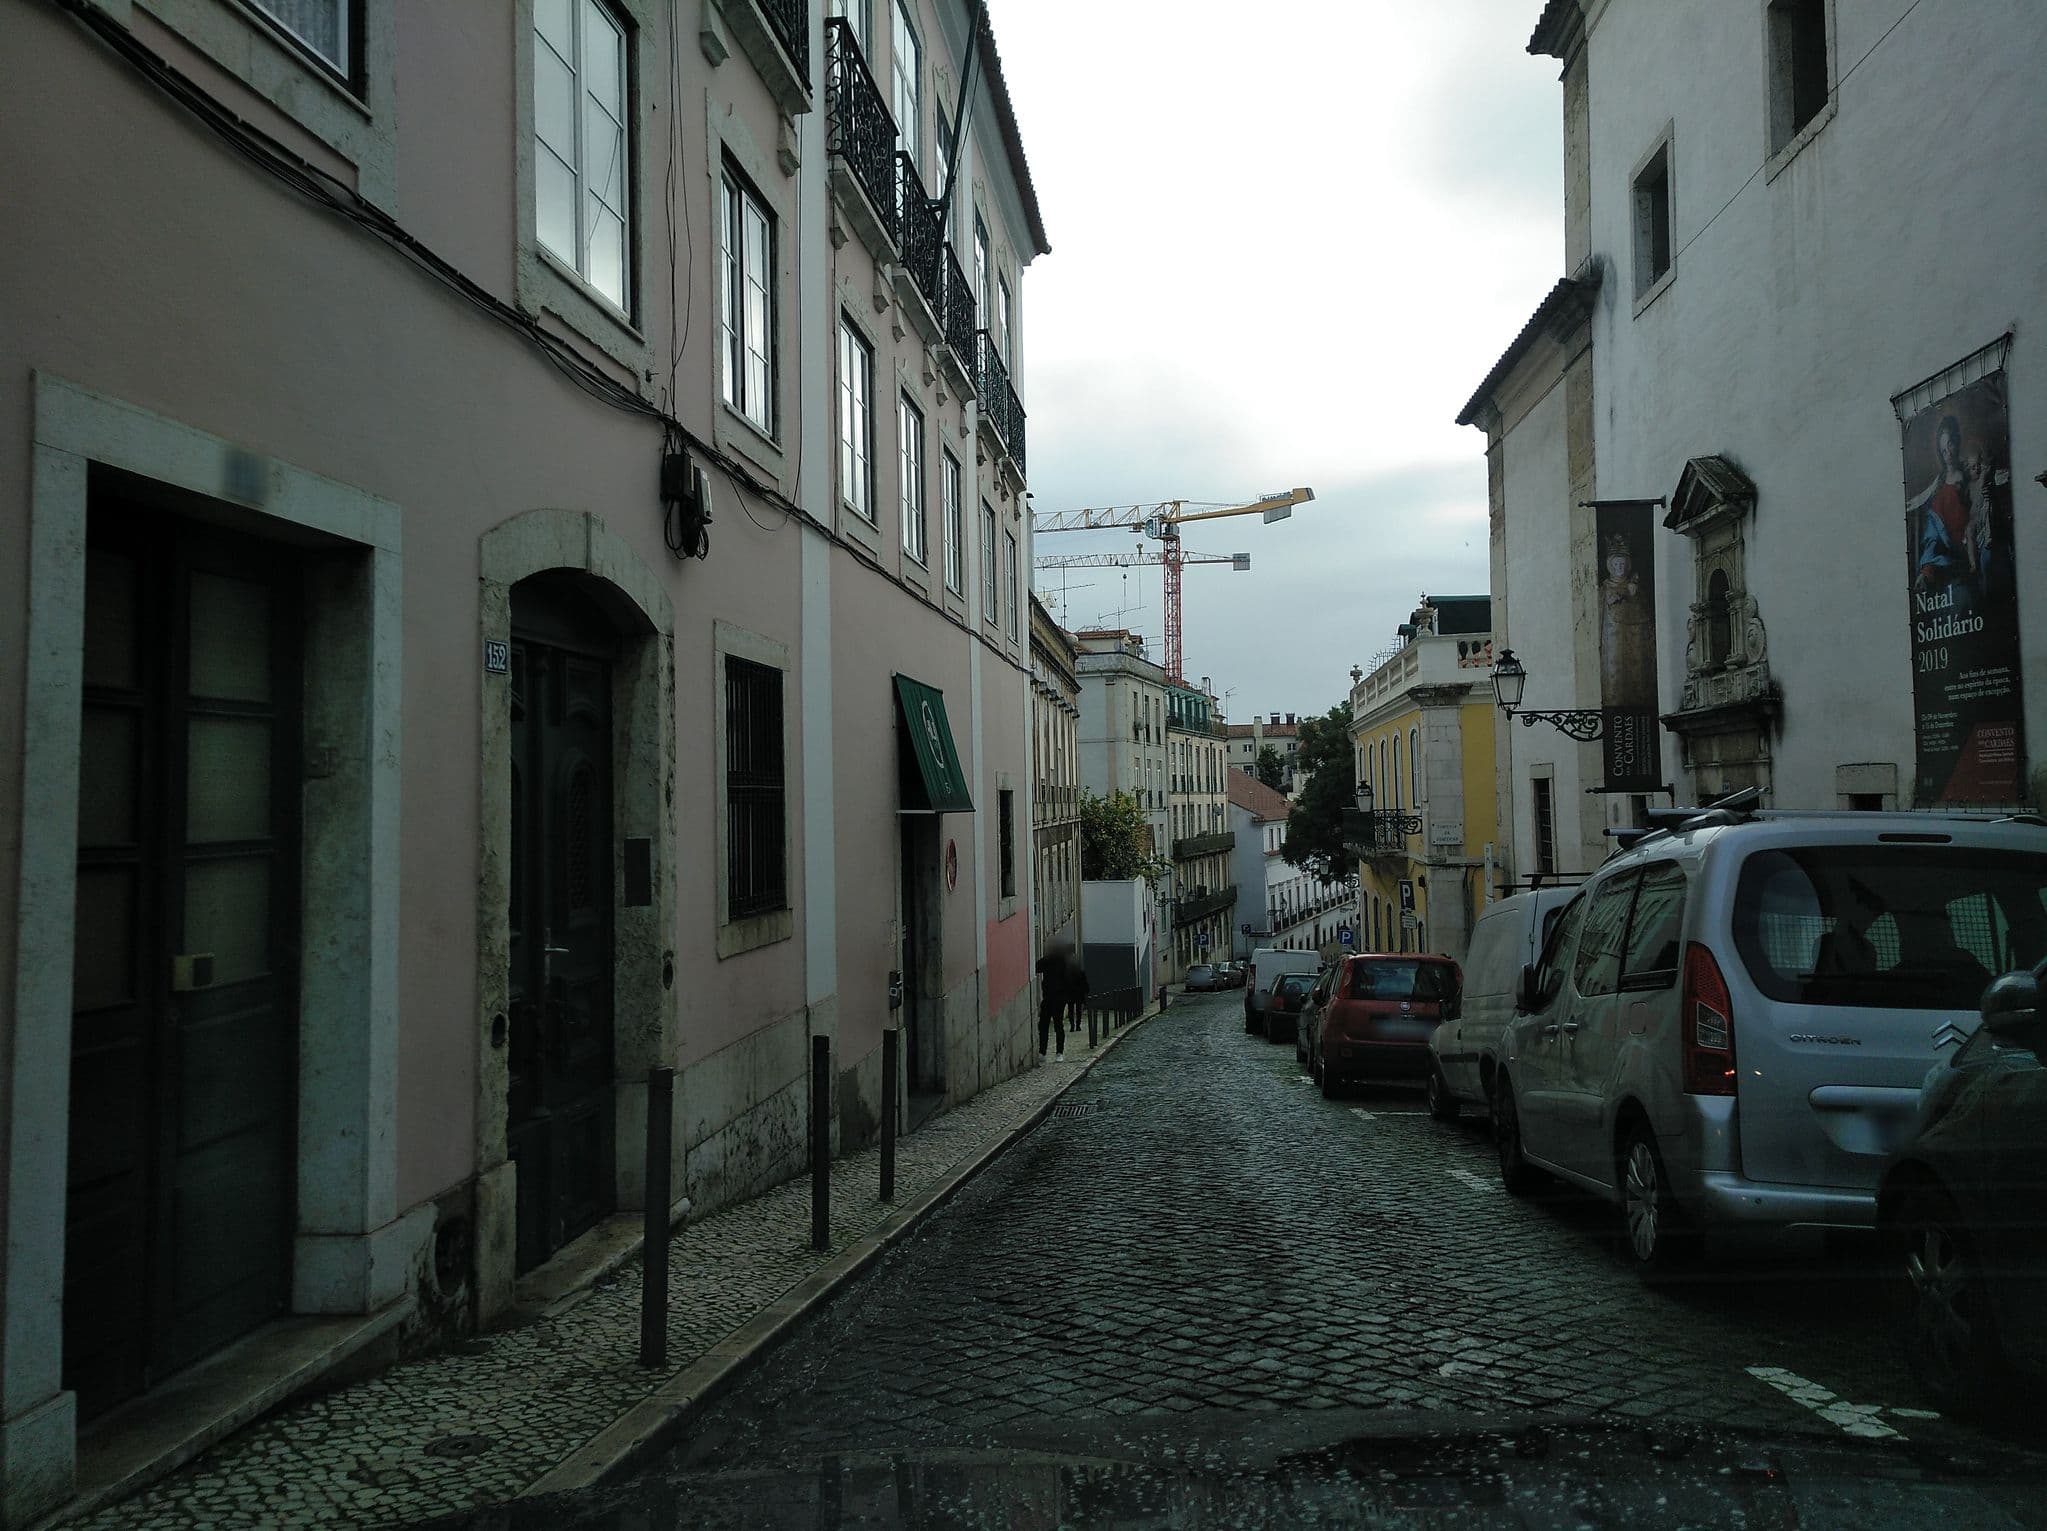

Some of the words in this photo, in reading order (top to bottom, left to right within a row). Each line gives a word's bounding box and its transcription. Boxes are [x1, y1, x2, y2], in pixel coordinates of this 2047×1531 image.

[1916, 584, 1954, 615] Natal
[1917, 609, 1984, 643] Solidário
[487, 642, 506, 670] 152
[1919, 646, 1948, 673] 2019
[1614, 715, 1623, 776] CONVENTO
[1977, 727, 2014, 737] CONVENTO
[1342, 931, 1351, 943] P
